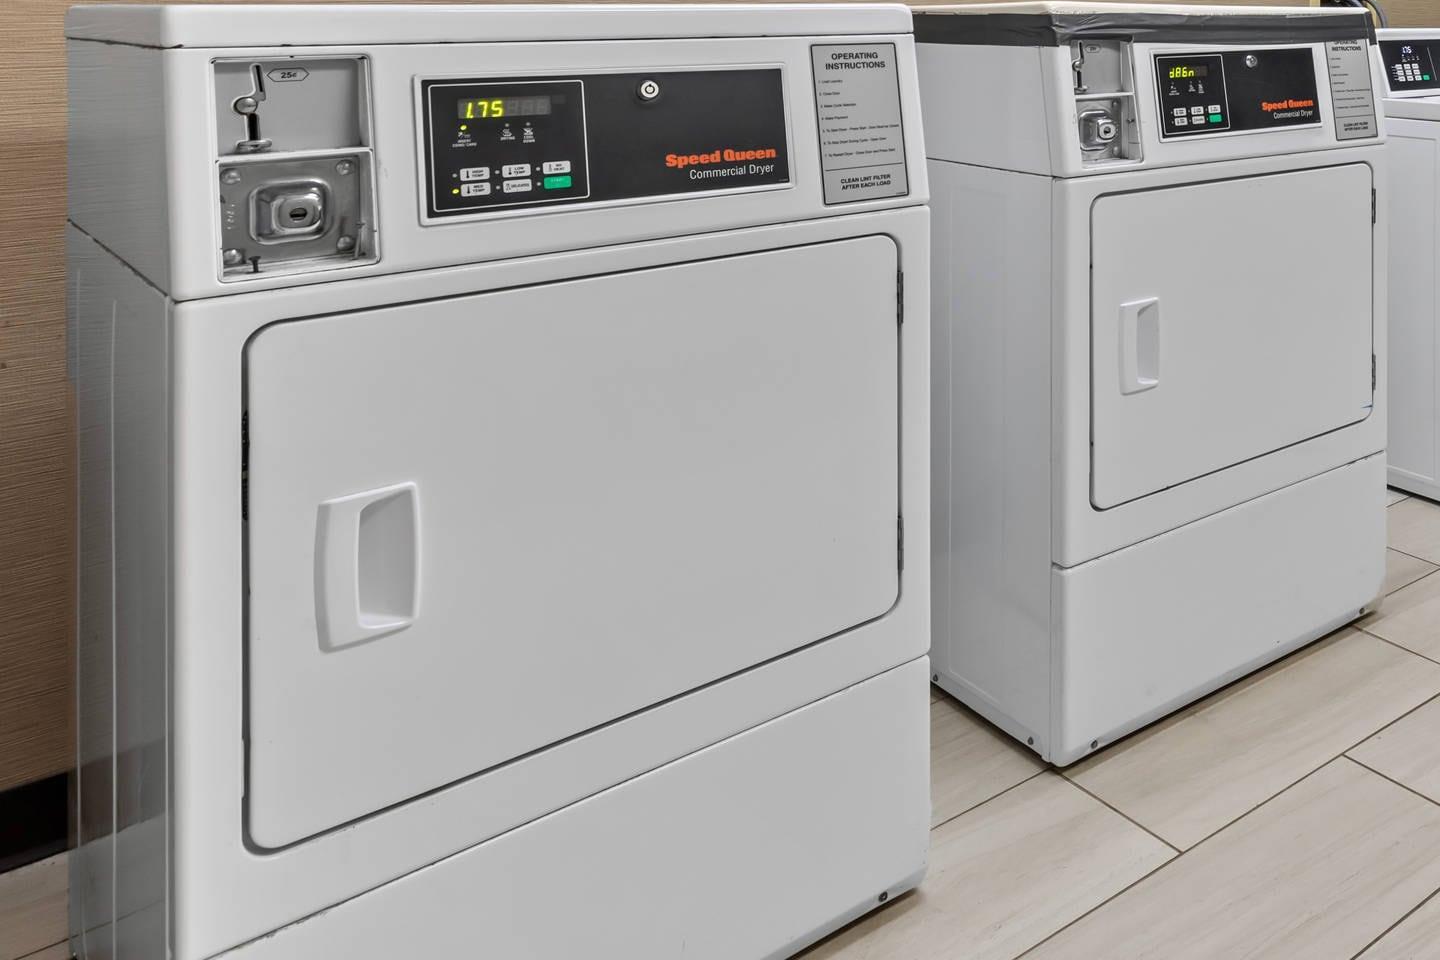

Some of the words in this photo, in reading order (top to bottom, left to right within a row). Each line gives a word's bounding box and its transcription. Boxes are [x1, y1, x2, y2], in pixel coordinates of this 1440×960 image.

[831, 52, 878, 60] OPERATING
[825, 61, 886, 70] INSTRUCTIONS
[1262, 100, 1288, 112] Speed
[1288, 99, 1313, 108] Queen
[1273, 110, 1300, 119] Commercial
[665, 150, 721, 168] Speed
[723, 148, 776, 162] Queen
[689, 166, 747, 180] Commercial
[749, 164, 775, 175] Dryer
[873, 173, 891, 181] FILTER
